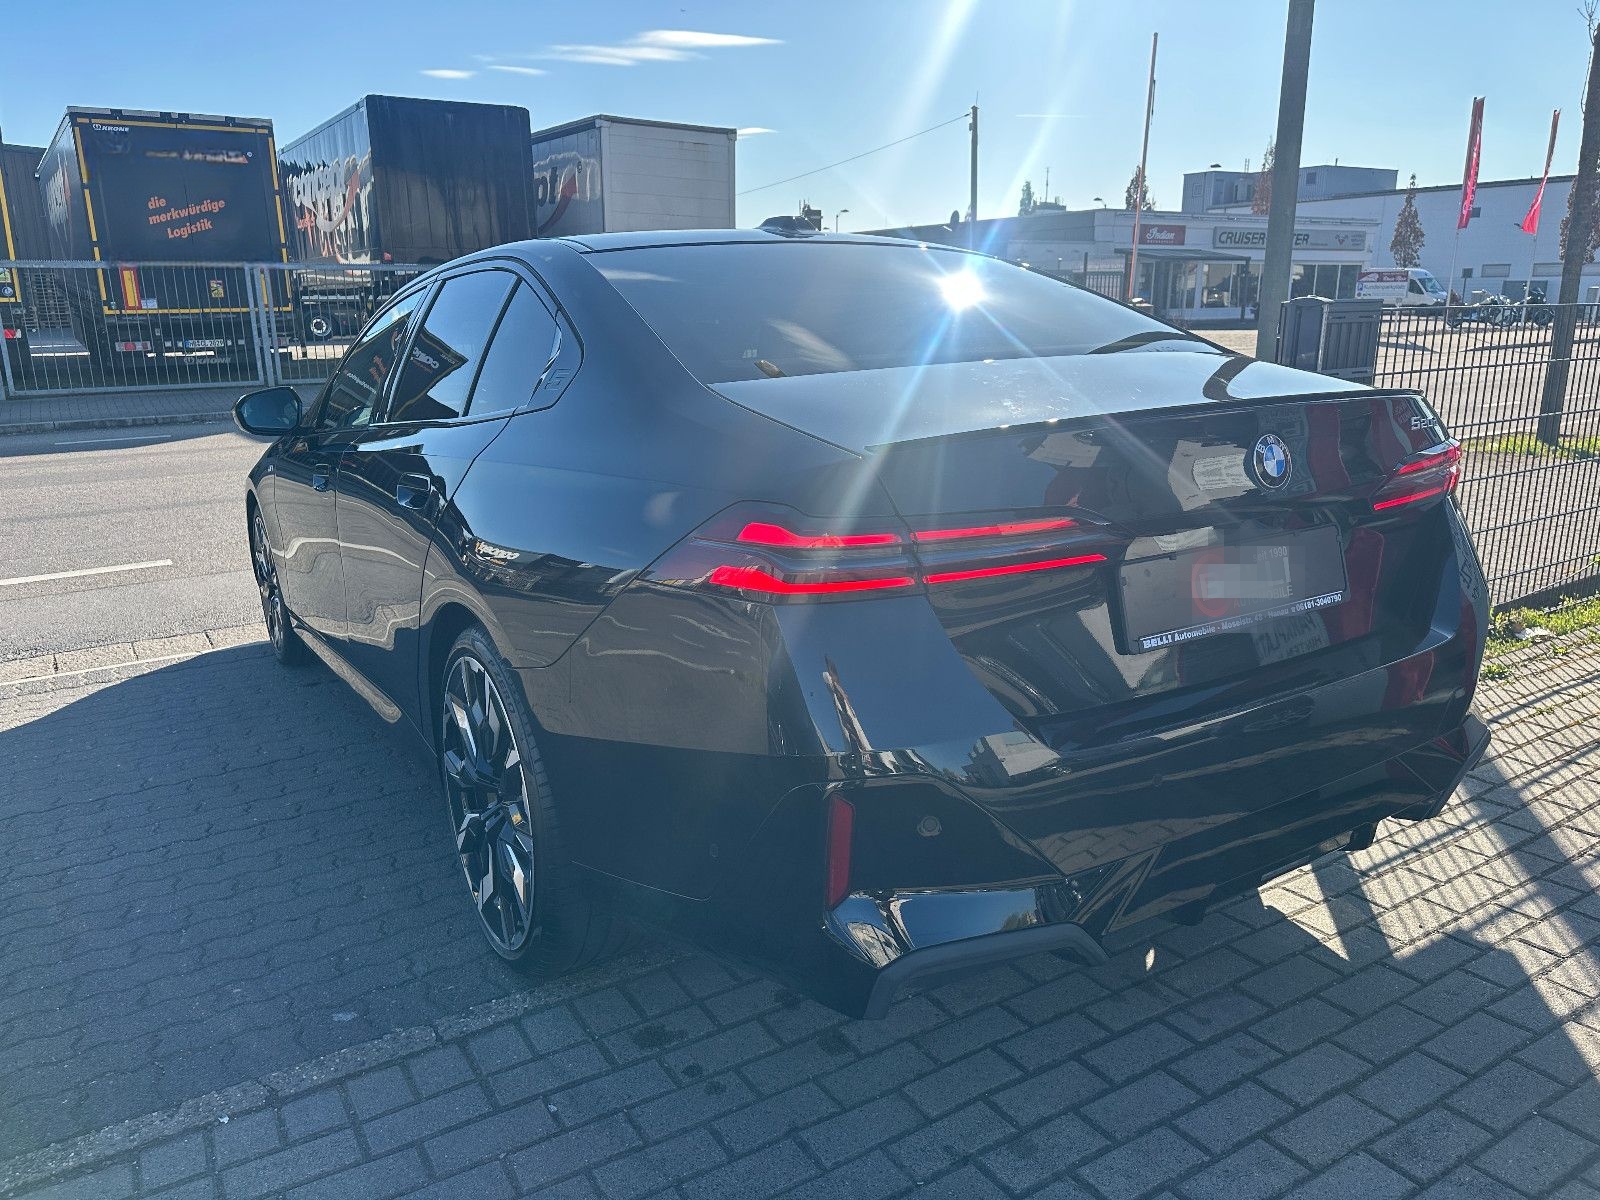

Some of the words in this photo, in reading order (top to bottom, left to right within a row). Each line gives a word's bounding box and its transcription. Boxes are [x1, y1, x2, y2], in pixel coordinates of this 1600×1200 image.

[147, 196, 167, 209] die
[148, 199, 226, 225] merkwürdige
[167, 218, 213, 239] Logistik
[1146, 226, 1176, 240] Indian
[1269, 546, 1288, 558] 1990
[1143, 635, 1173, 649] BELLI
[1174, 625, 1216, 642] Automobile
[1221, 617, 1253, 631] Moselstr.
[1267, 608, 1289, 619] Hanau
